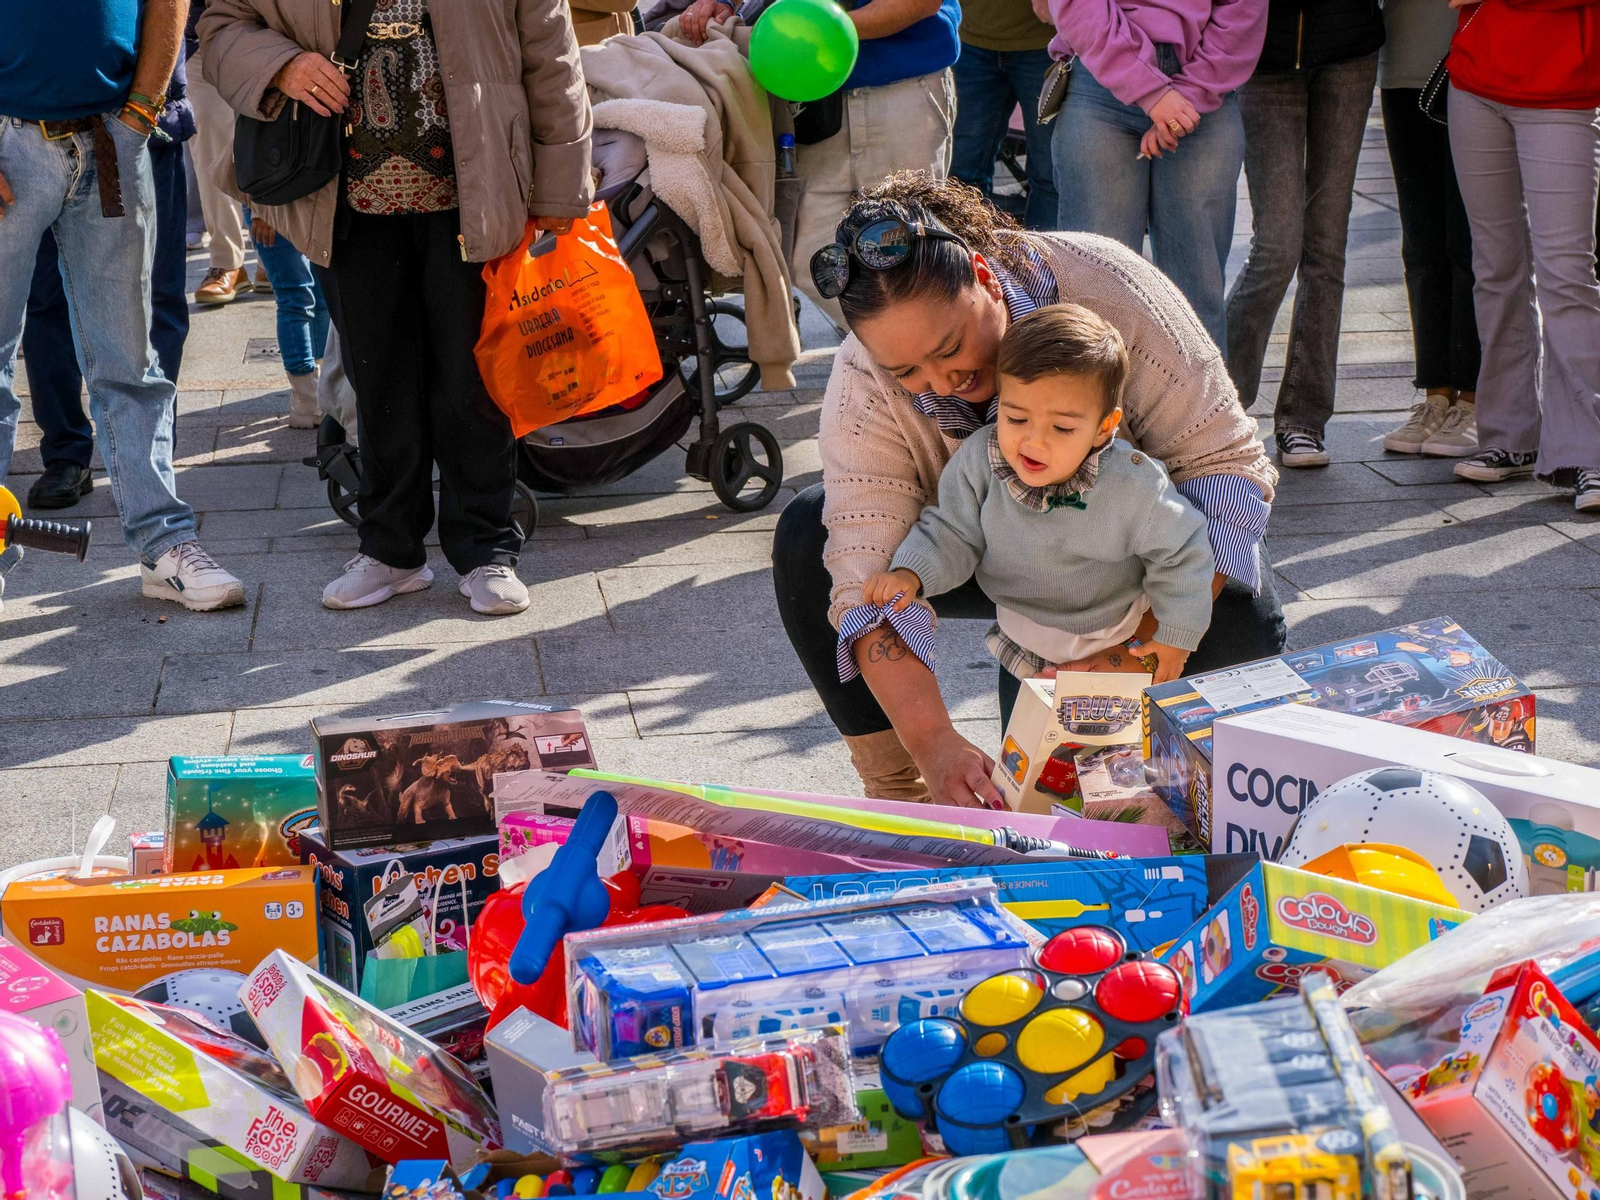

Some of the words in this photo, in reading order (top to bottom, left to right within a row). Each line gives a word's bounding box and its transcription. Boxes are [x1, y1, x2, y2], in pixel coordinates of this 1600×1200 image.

[509, 277, 566, 312] Asidonia
[518, 307, 562, 337] LIBRERIA
[525, 327, 575, 359] DIOCESANA
[1459, 678, 1513, 698] RESCUE
[1060, 695, 1142, 722] TRUCK
[1495, 711, 1509, 721] 42
[453, 726, 485, 740] TRUCK
[1076, 725, 1110, 733] DRIVER
[329, 750, 378, 763] DINOSAUR
[215, 767, 230, 775] fine
[234, 766, 253, 774] your
[1197, 767, 1210, 839] RESCUE
[633, 820, 642, 839] cute
[159, 880, 224, 888] RANAS
[1010, 880, 1049, 889] THUNDER
[287, 903, 302, 916] 3+
[814, 892, 872, 908] SUPER
[94, 912, 171, 934] RANAS
[585, 929, 607, 937] SET
[610, 923, 654, 933] TRUCK
[1307, 919, 1349, 937] Dough
[95, 930, 231, 953] CAZABOLAS
[185, 952, 224, 960] caccia-palle
[196, 958, 241, 966] attrape-boules
[252, 970, 280, 1008] Fast
[247, 986, 265, 1017] The
[389, 1010, 407, 1019] EW
[408, 998, 445, 1012] ITEMS
[101, 1025, 122, 1041] Love
[123, 1035, 138, 1050] life
[138, 1044, 155, 1060] and
[156, 1056, 176, 1073] food
[109, 1016, 126, 1032] Fun
[126, 1023, 146, 1043] little
[147, 1036, 178, 1062] cutlery
[333, 1018, 370, 1075] GOURMET
[91, 1031, 108, 1048] et's
[108, 1040, 129, 1058] have
[129, 1051, 144, 1066] fun
[145, 1061, 180, 1087] together
[97, 1044, 112, 1059] the
[113, 1053, 146, 1079] moment
[146, 1076, 165, 1092] play
[166, 1086, 185, 1103] time
[263, 1104, 296, 1137] The
[348, 1083, 439, 1142] GOURMET
[1502, 1098, 1528, 1129] FLASHING
[511, 1114, 539, 1136] FAST
[246, 1117, 295, 1158] Fast
[1508, 1116, 1527, 1140] SOUND
[1526, 1137, 1549, 1163] EFFECTS
[245, 1136, 283, 1170] Food
[645, 1171, 710, 1195] PAW
